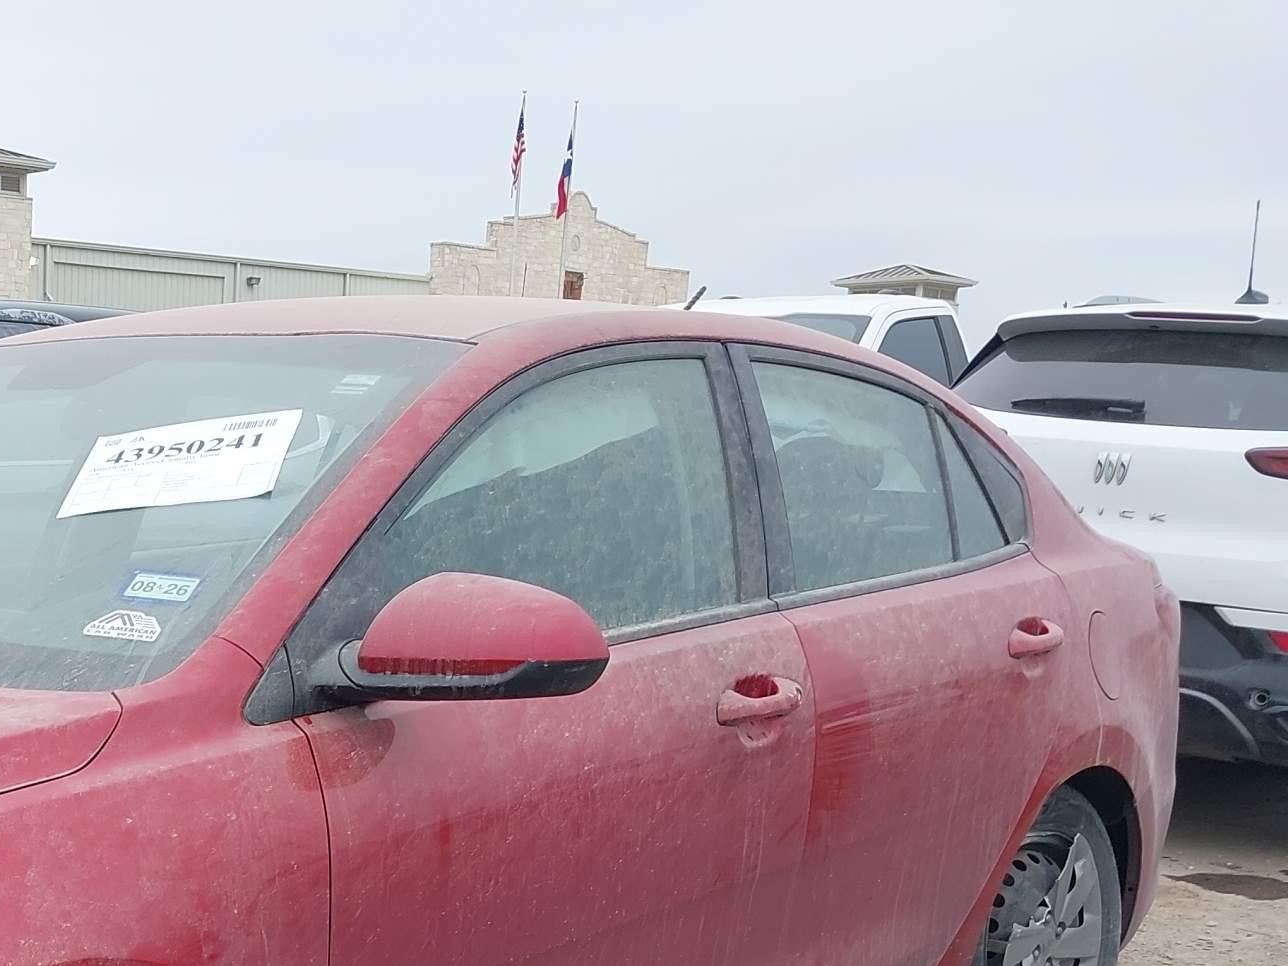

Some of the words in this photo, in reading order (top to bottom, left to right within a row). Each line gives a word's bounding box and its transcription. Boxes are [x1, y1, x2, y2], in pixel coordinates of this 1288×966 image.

[105, 433, 264, 464] 43950241
[131, 581, 156, 592] 08
[163, 583, 190, 596] 26
[107, 624, 158, 636] AMERICAN
